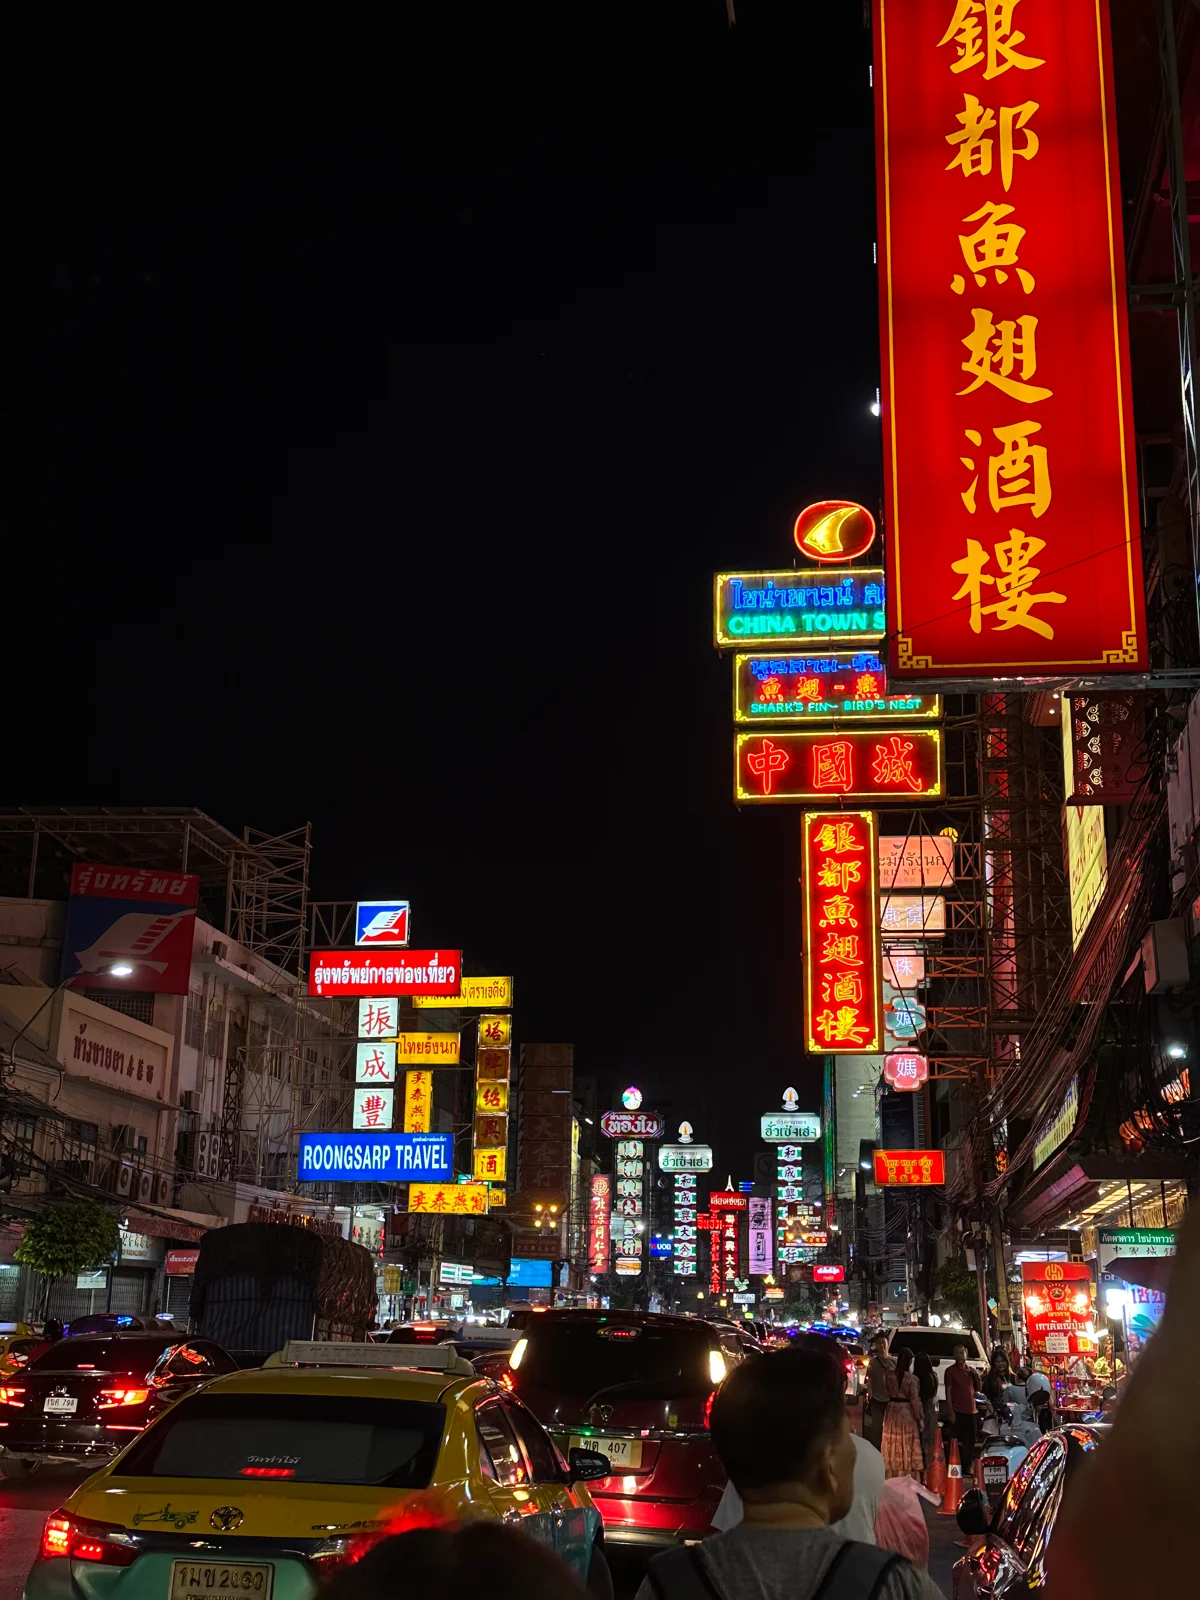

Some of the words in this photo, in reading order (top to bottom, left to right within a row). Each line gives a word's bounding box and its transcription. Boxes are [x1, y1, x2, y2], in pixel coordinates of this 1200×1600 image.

[935, 0, 1067, 641] 銀都魚翅酒樓
[730, 578, 854, 608] ไชน่าทาวน์
[728, 616, 796, 634] CHINA
[802, 612, 867, 632] TOWN
[750, 701, 804, 714] SHARK'S
[844, 700, 885, 711] BIRD'S
[890, 699, 922, 710] NEST
[747, 736, 922, 795] 中國城
[77, 866, 193, 896] รุ่งทรัพย์
[813, 821, 870, 1045] 銀都魚翅酒樓
[314, 953, 456, 995] รุ่งทรัพย์การท่องเที่ยว
[608, 1115, 658, 1133] ทองใบ
[303, 1144, 391, 1170] ROONGSARP
[395, 1145, 448, 1170] TRAVEL
[784, 1147, 798, 1262] 和成興行
[607, 1442, 627, 1454] 407
[219, 1569, 264, 1590] 2060
